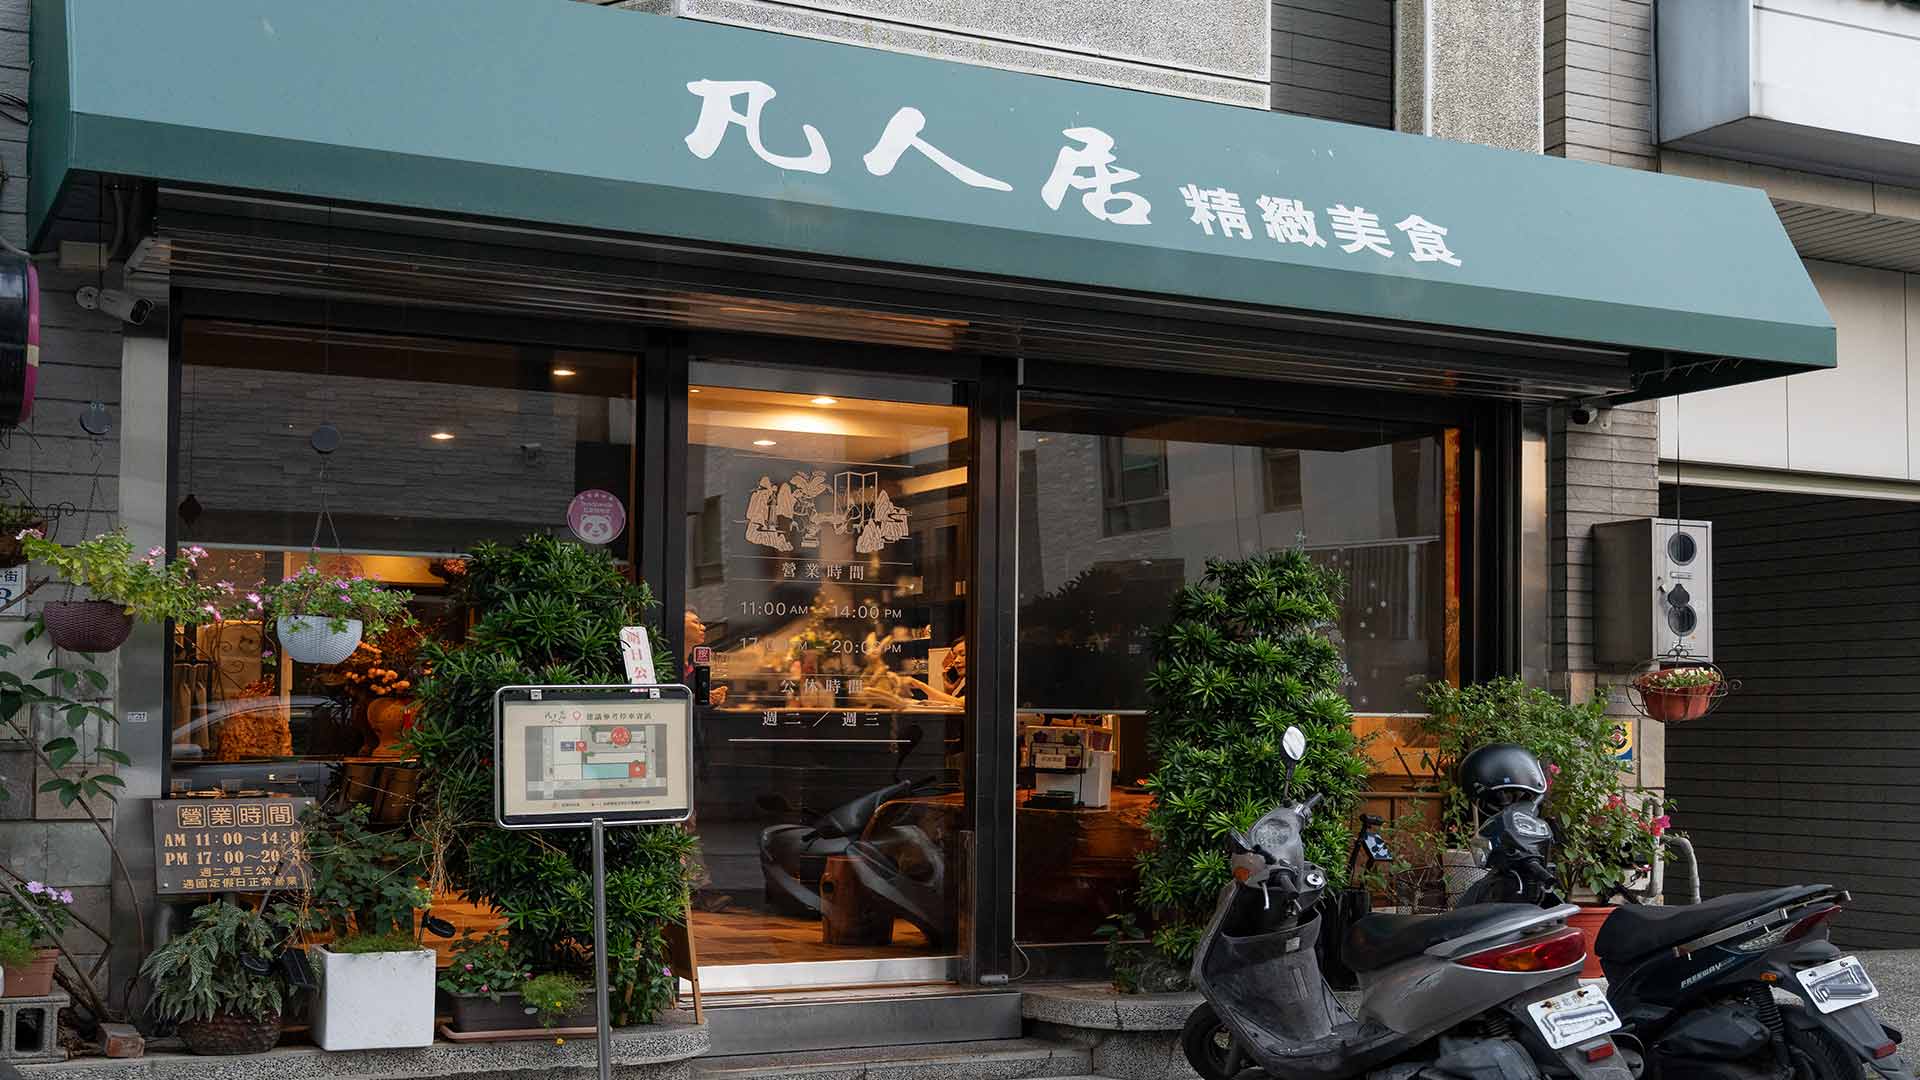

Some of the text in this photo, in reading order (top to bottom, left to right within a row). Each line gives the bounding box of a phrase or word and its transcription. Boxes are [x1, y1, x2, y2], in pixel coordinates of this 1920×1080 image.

[685, 79, 1462, 267] 凡人居 精緻美食
[0, 569, 18, 583] 街
[782, 561, 865, 581] 營業時間
[740, 601, 786, 616] 11:00
[789, 605, 809, 615] AM
[831, 604, 880, 619] 14:00
[884, 608, 902, 618] PM
[779, 678, 865, 695] 公休時間
[180, 804, 292, 827] 營業時間
[163, 830, 303, 848] AM 11:00～14:0
[165, 852, 189, 866] PM
